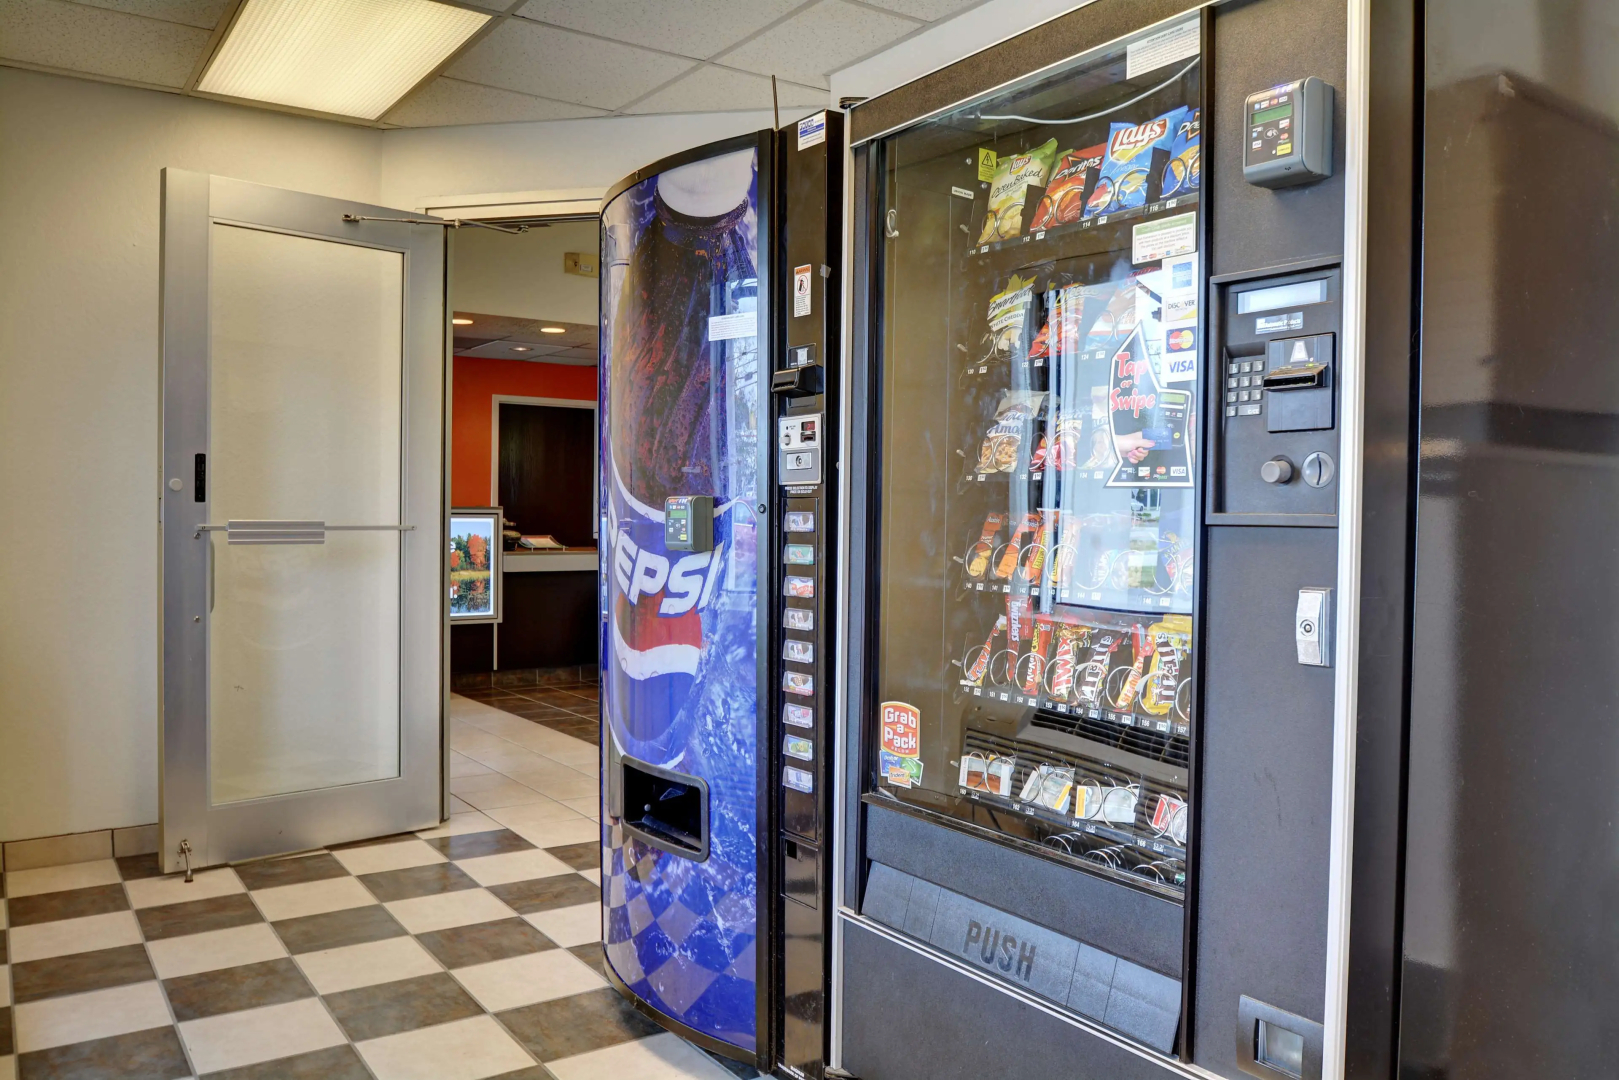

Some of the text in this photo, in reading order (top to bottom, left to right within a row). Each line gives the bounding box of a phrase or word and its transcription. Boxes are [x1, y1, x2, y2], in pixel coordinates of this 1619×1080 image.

[1014, 168, 1042, 184] Baked
[1149, 204, 1159, 212] 116
[1082, 221, 1091, 229] 114
[1004, 312, 1024, 322] CHEDDA
[1115, 352, 1148, 384] Tap
[1170, 360, 1194, 373] VISA
[1120, 380, 1133, 388] or
[1110, 387, 1156, 418] Swipe
[608, 491, 725, 614] PEPSI
[1010, 599, 1022, 642] Twizzlers
[1052, 637, 1074, 695] TWIX
[884, 707, 917, 729] Grab
[896, 724, 905, 734] a
[884, 726, 917, 749] Pack
[963, 919, 1037, 982] PUSH
